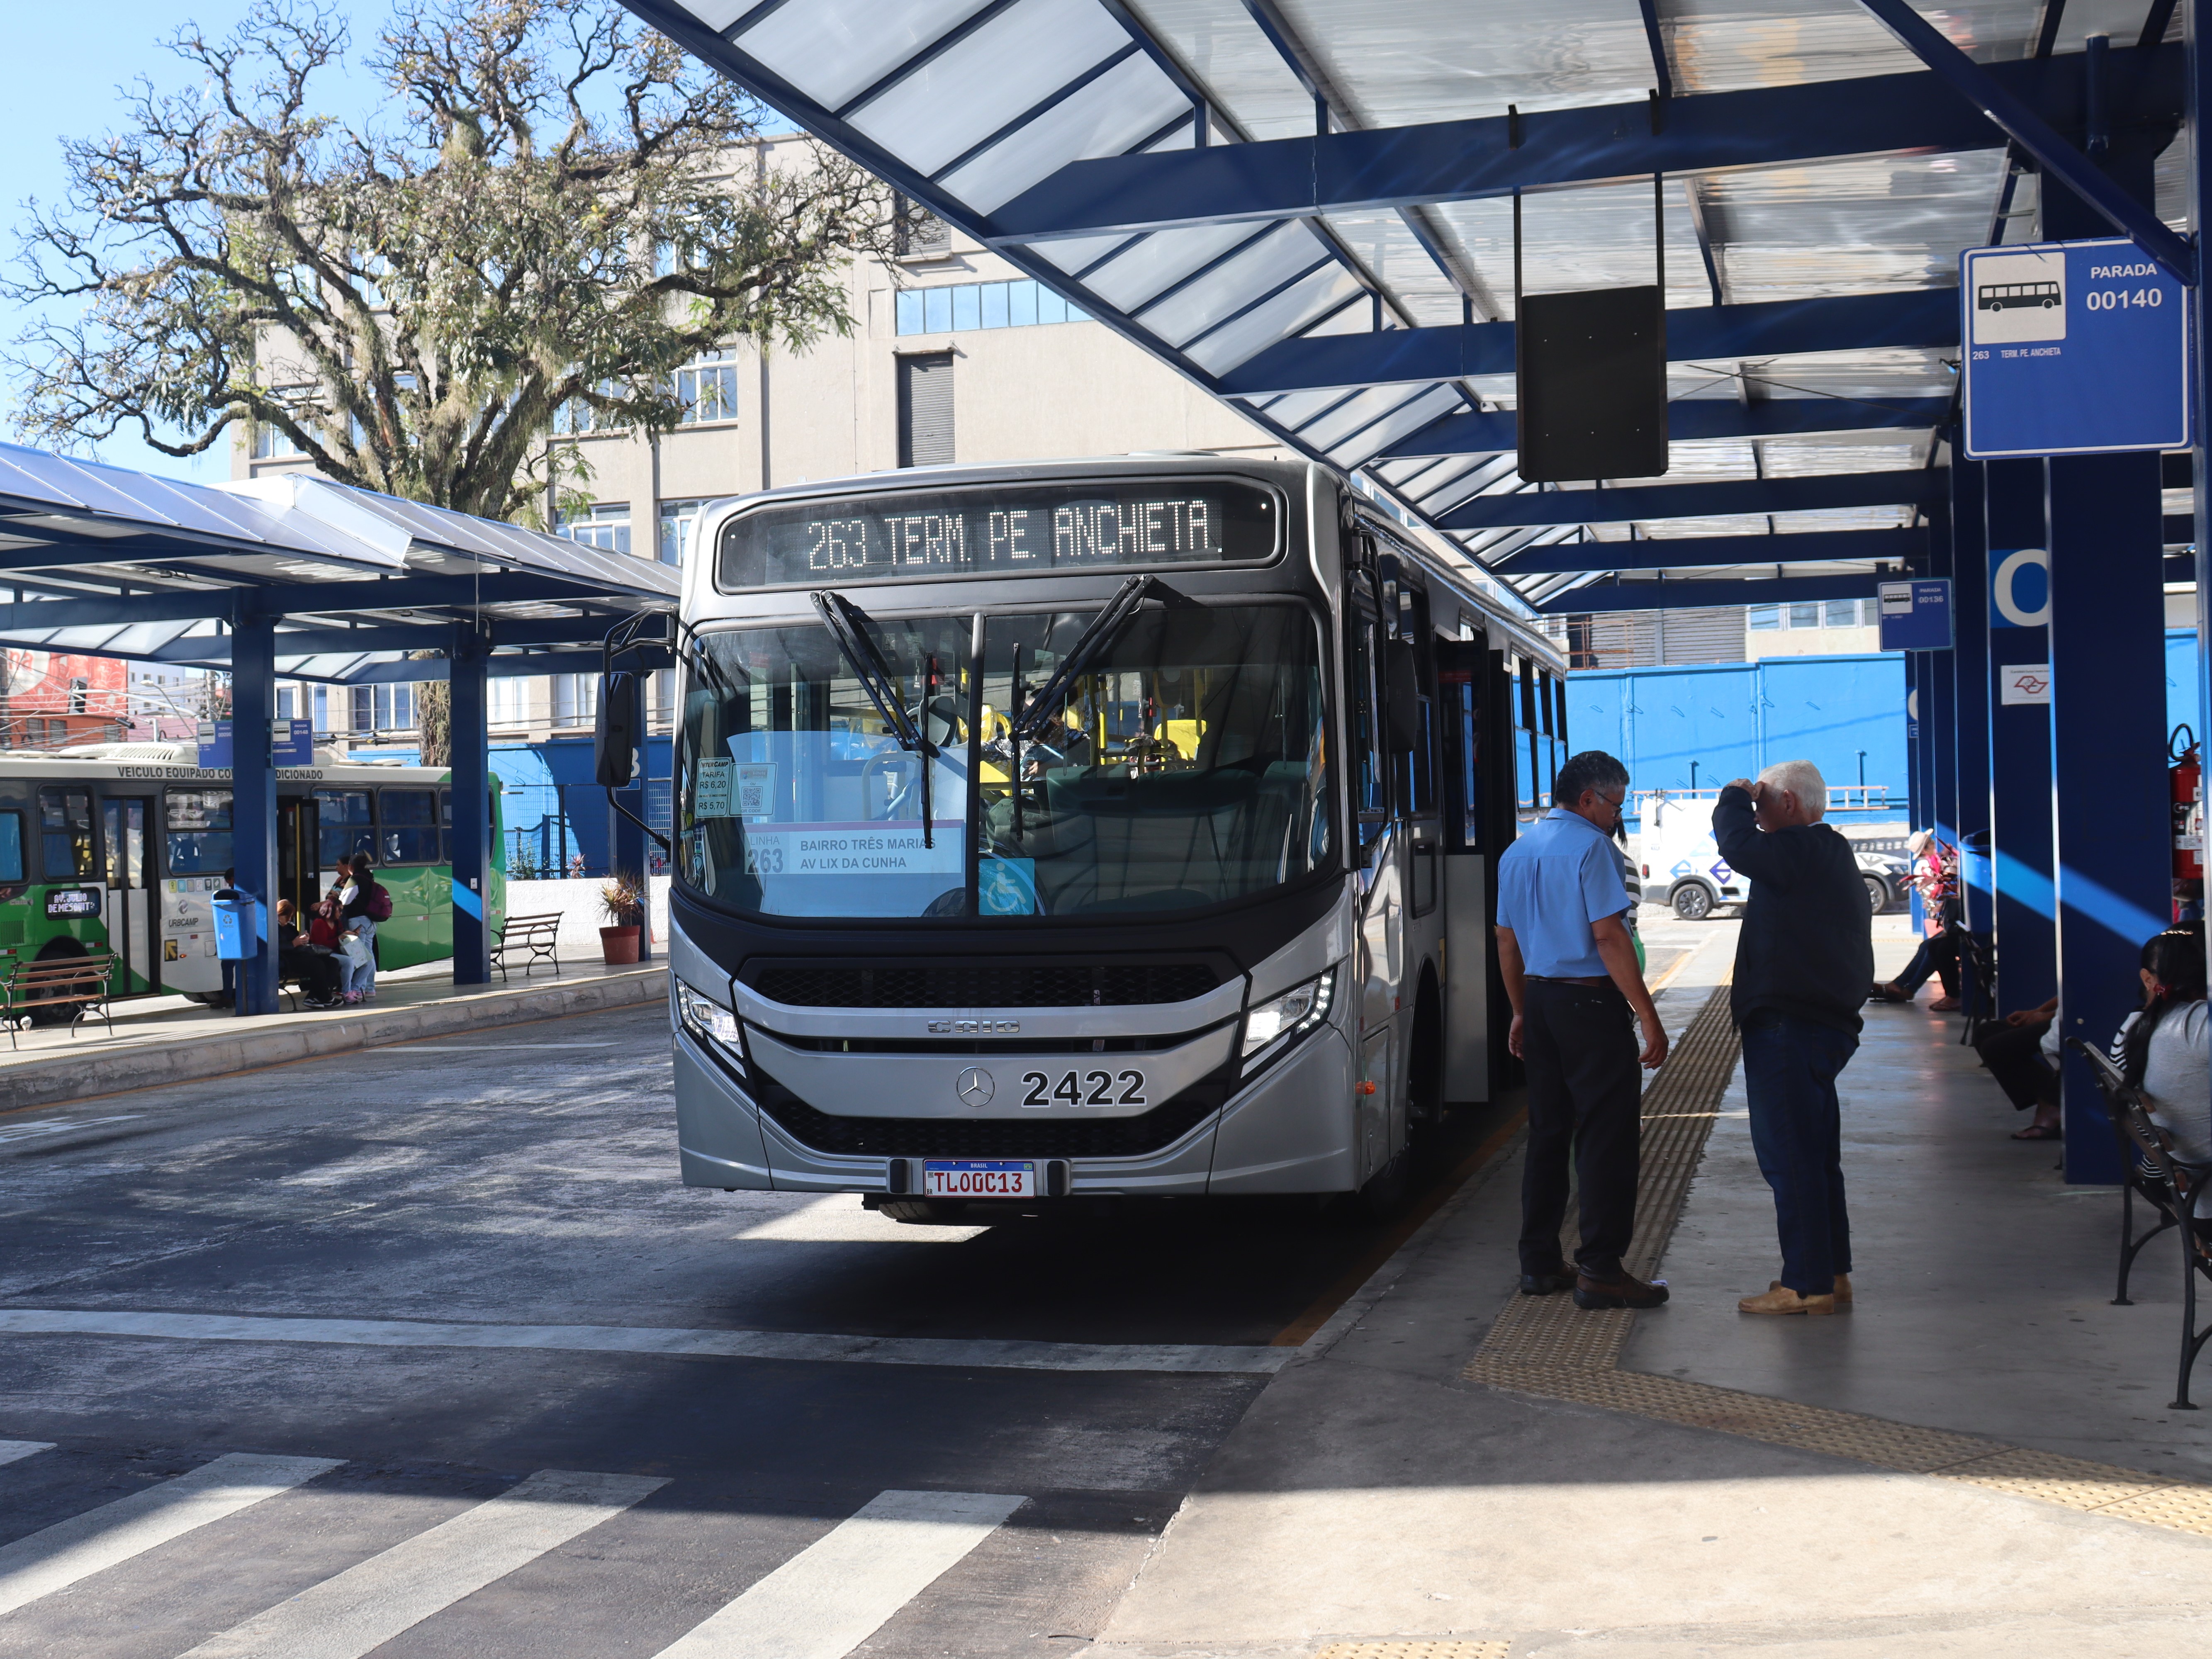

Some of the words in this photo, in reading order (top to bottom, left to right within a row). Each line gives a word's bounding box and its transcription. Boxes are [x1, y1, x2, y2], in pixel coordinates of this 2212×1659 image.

[2090, 263, 2158, 279] PARADA
[2086, 288, 2162, 311] 00140
[1972, 350, 1990, 360] 263
[2000, 349, 2019, 358] TERM.
[2020, 348, 2029, 358] PE.
[2030, 347, 2061, 357] ANCHIETA
[808, 519, 866, 570] 263
[884, 513, 971, 566] TERM.
[989, 509, 1036, 560] PE.
[1054, 500, 1209, 557] ANCHIETA
[166, 766, 215, 778] EQUIPADO
[218, 768, 233, 778] CO
[711, 781, 726, 789] 6,20
[709, 801, 725, 810] 5,70
[750, 836, 780, 846] LINHA
[801, 840, 847, 851] BAIRRO
[851, 837, 883, 850] TRÊS
[887, 838, 936, 850] MARIAS
[748, 848, 784, 874] 263
[801, 858, 816, 869] AV
[820, 858, 838, 869] LIX
[842, 858, 859, 868] DA
[862, 857, 907, 868] CUNHA
[168, 917, 199, 927] URBCAMP
[928, 1020, 1020, 1033] CAIO
[1021, 1069, 1146, 1108] 2422
